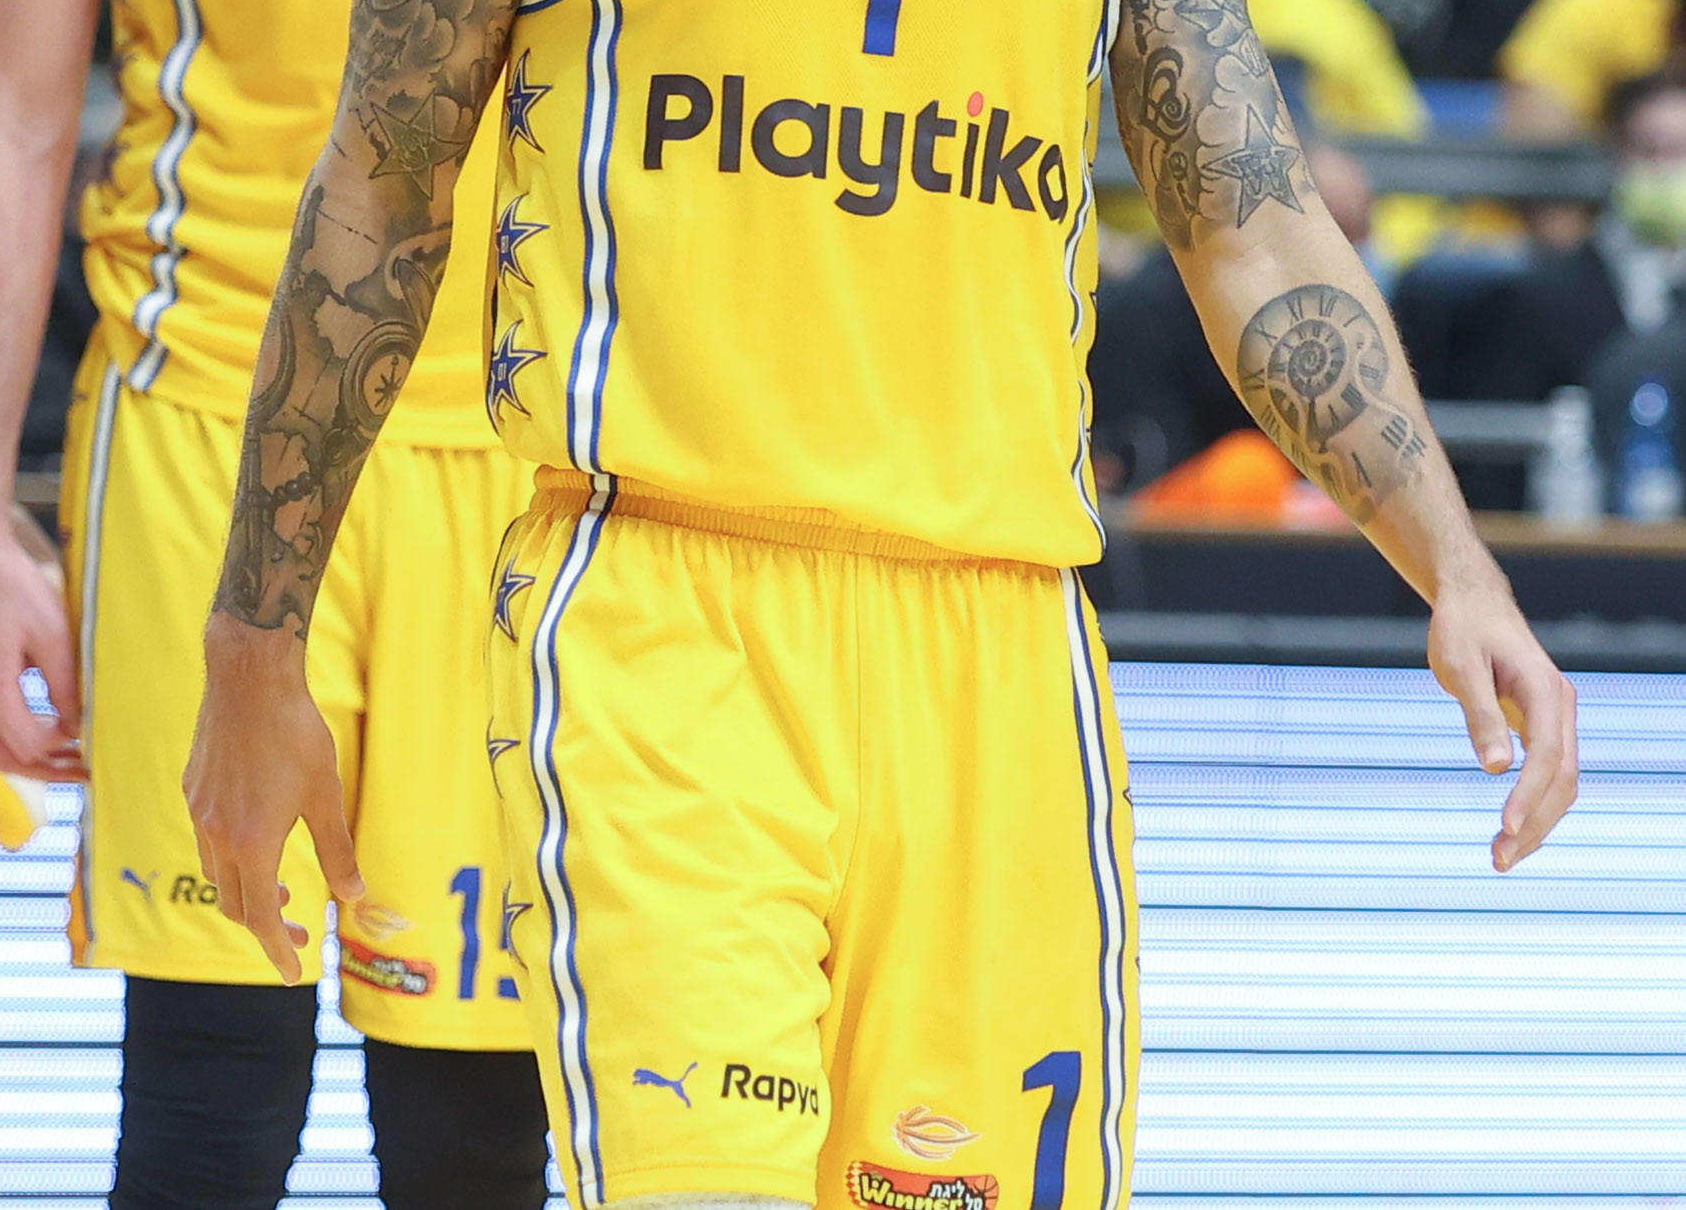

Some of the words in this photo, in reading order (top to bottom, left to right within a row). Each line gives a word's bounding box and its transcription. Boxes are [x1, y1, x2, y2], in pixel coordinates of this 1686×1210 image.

[642, 74, 1069, 225] Playtika
[170, 875, 218, 904] Ra
[1022, 1051, 1081, 1210] 1
[861, 1174, 964, 1210] Winner
